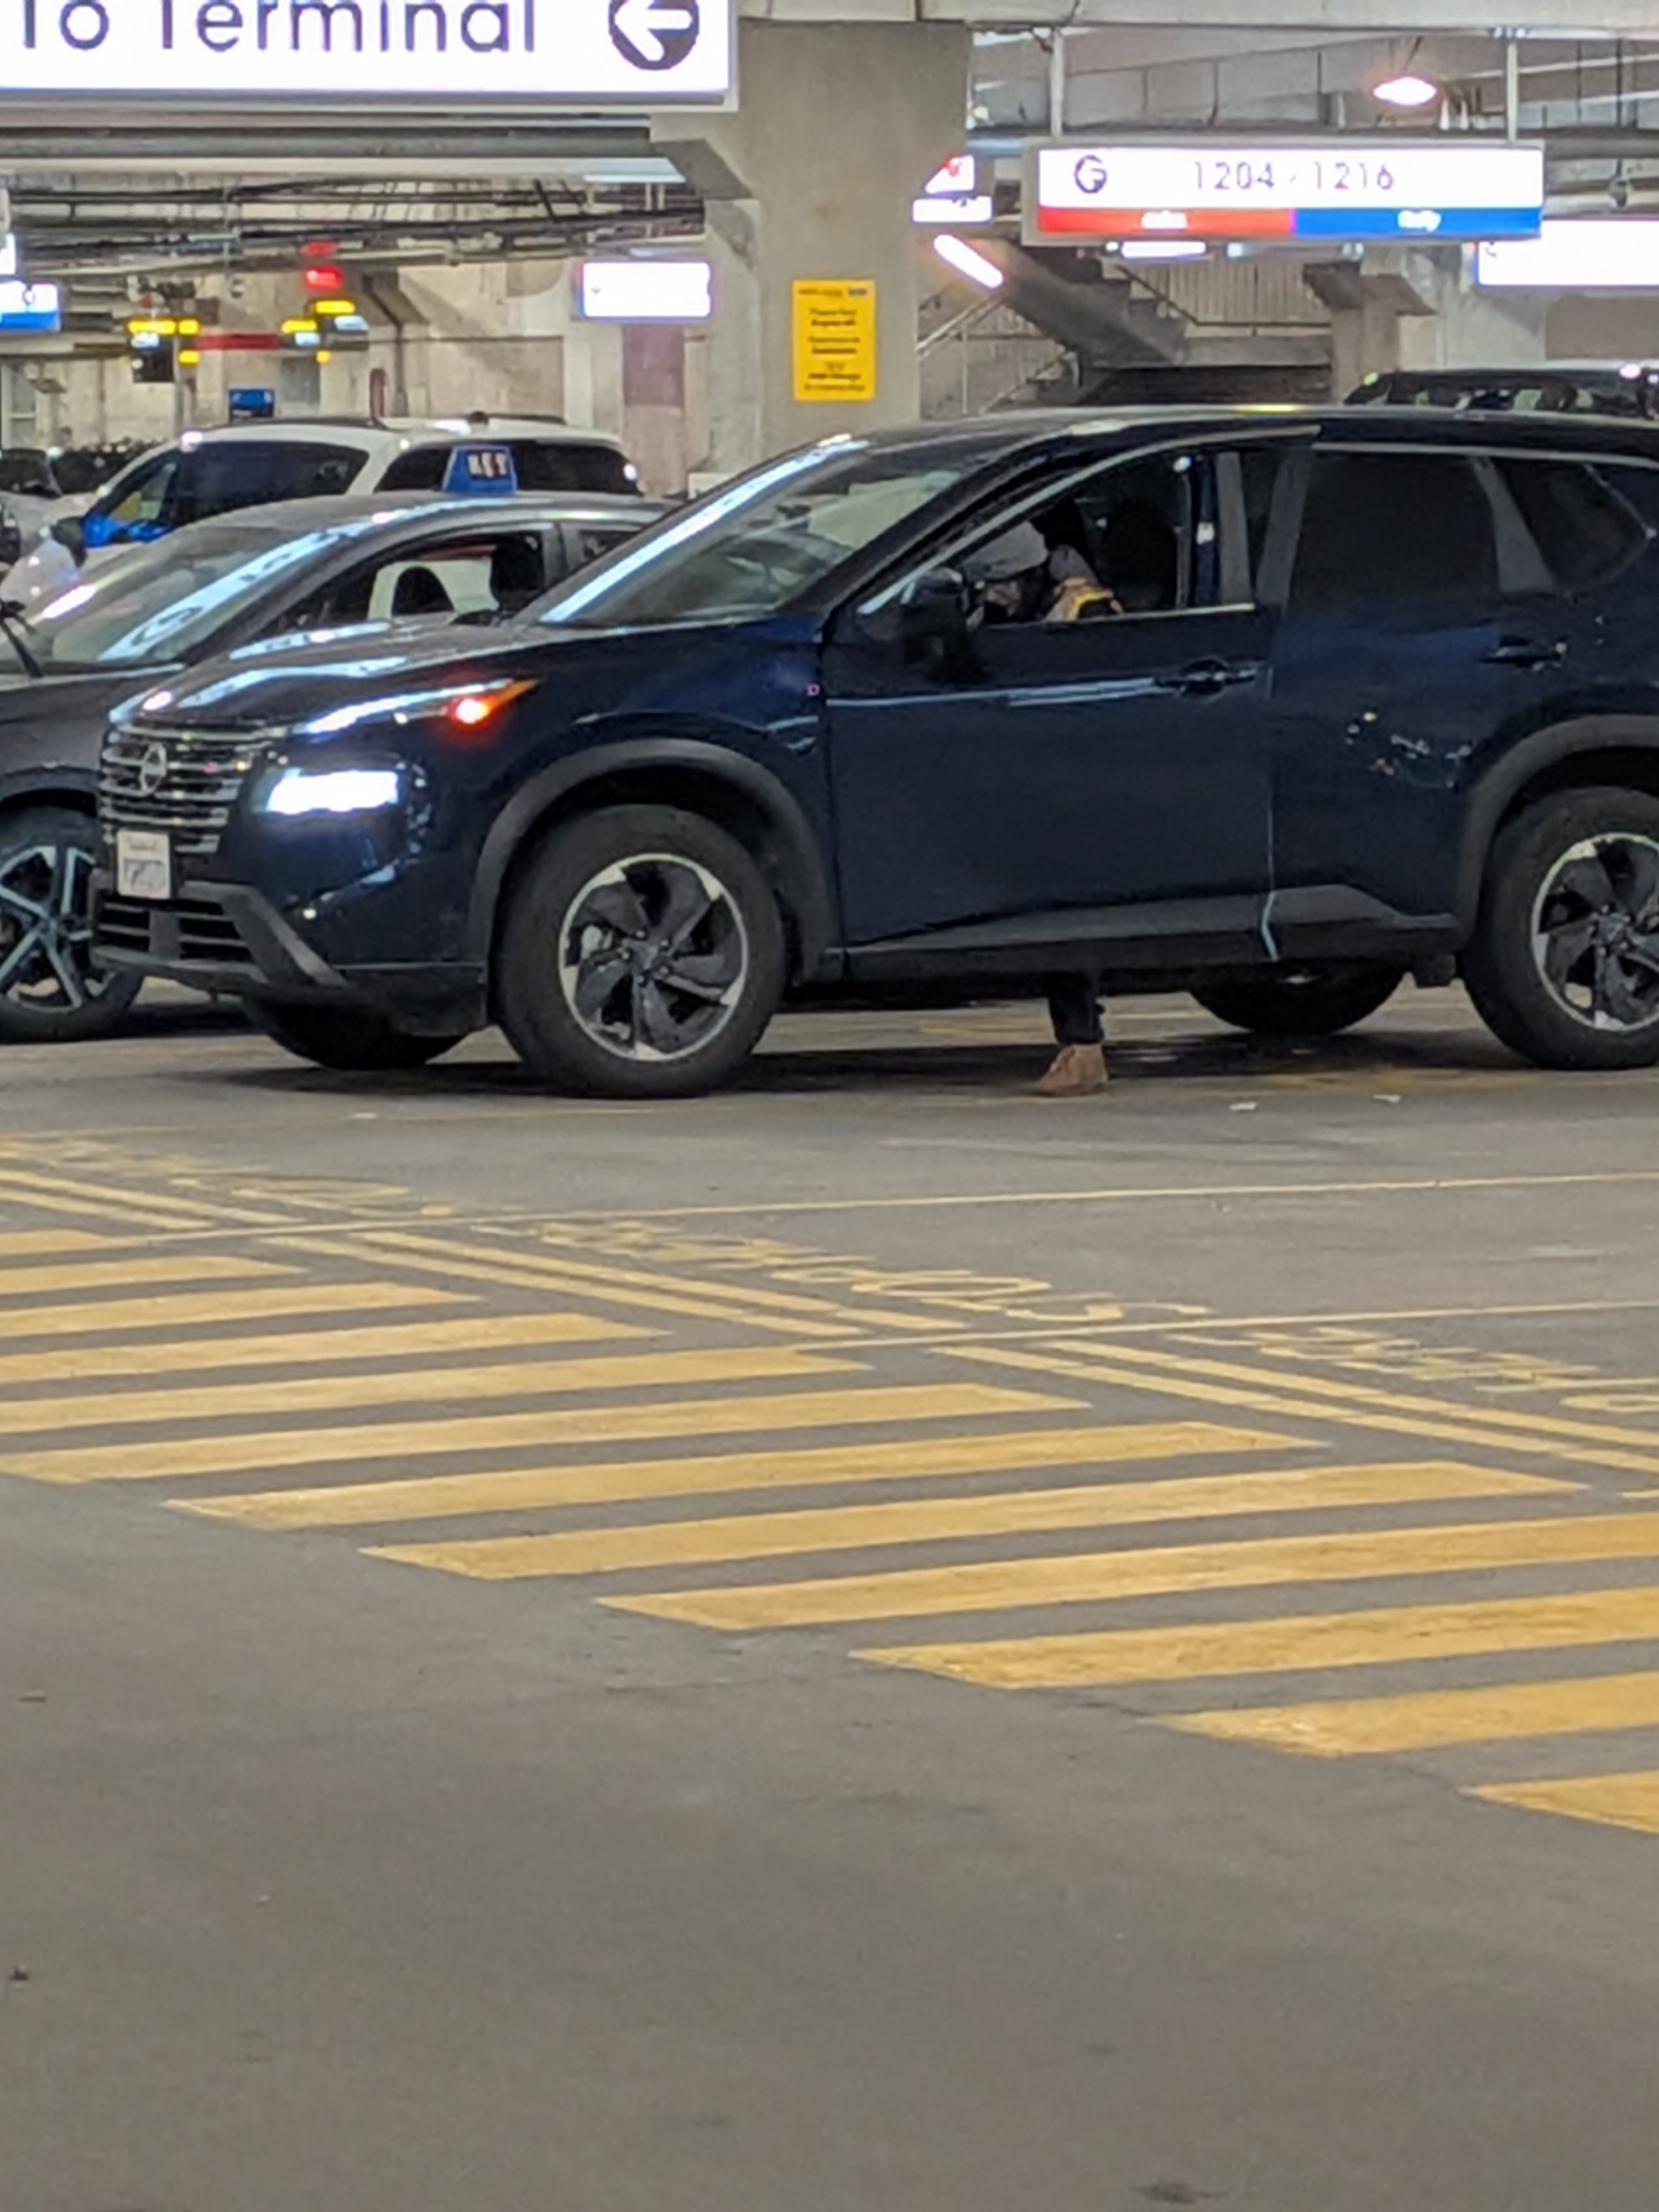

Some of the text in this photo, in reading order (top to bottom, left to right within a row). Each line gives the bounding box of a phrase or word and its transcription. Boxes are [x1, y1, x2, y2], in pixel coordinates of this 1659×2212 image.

[24, 0, 535, 52] To Terminal
[1194, 160, 1274, 190] 1204
[1313, 160, 1394, 190] 1216
